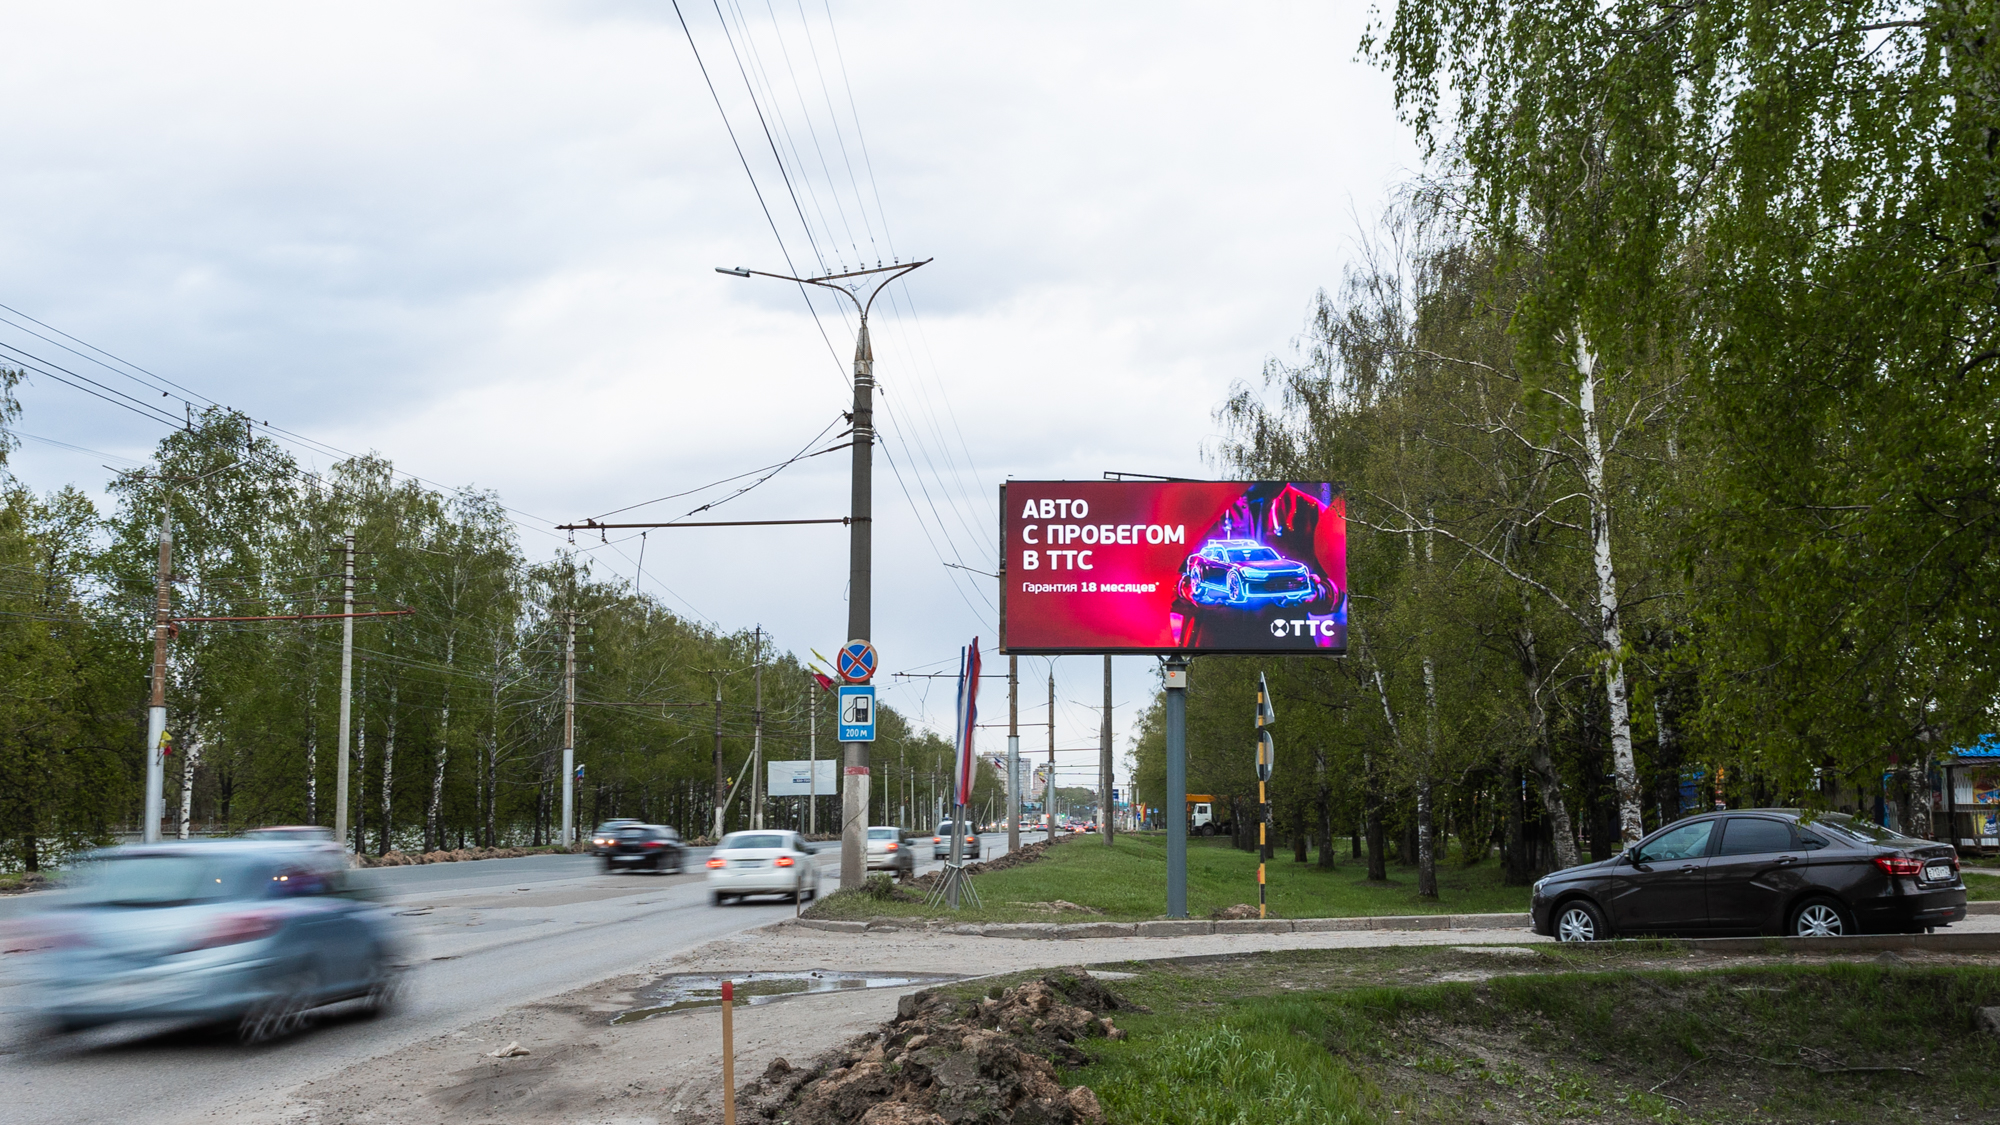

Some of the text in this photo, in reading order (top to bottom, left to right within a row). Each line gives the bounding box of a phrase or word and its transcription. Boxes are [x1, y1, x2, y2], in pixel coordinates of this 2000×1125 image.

[1022, 499, 1089, 519] АВТО
[1022, 524, 1185, 545] С ПРОБЕГОМ
[1023, 550, 1094, 570] В ТТС
[1022, 581, 1078, 594] Гарантия
[1081, 582, 1097, 592] 18
[1290, 619, 1335, 637] ТТС
[845, 728, 860, 738] 200
